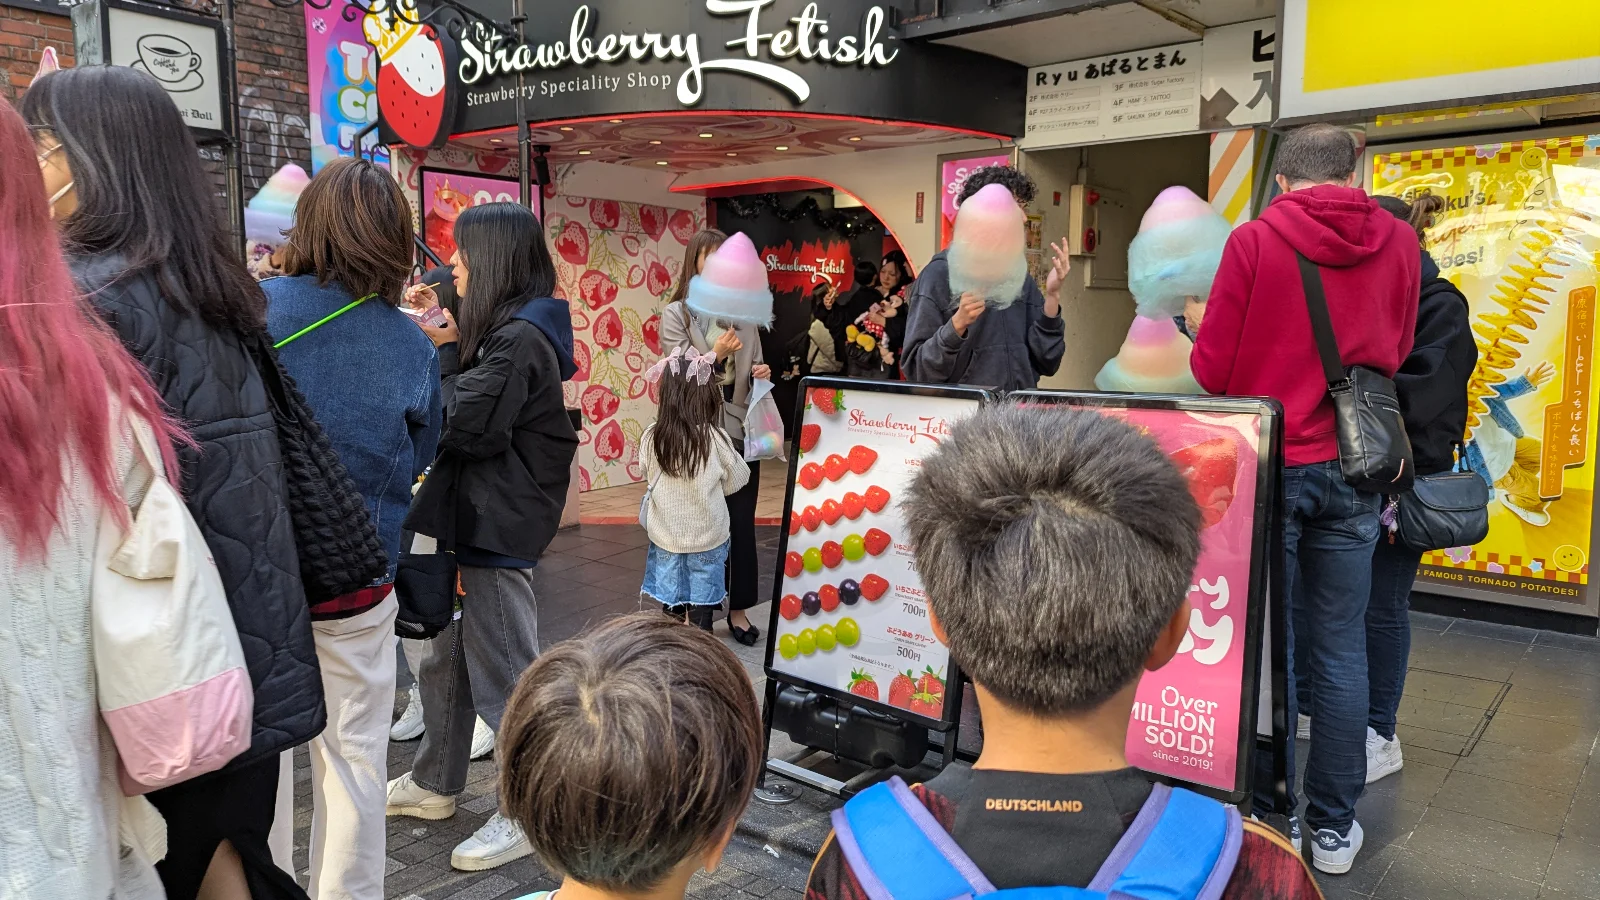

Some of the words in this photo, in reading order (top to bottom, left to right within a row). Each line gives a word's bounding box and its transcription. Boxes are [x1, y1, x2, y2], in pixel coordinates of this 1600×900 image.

[459, 4, 703, 105] Strawberry
[706, 0, 899, 65] Fetish
[1036, 70, 1078, 86] Ryu
[1085, 49, 1187, 79] あぱるとまん
[467, 85, 536, 107] Strawberry
[540, 74, 621, 97] Speciality
[627, 72, 672, 91] Shop
[1115, 84, 1124, 92] 3F
[1029, 95, 1038, 103] 2F
[1113, 99, 1124, 107] 4F
[191, 109, 213, 121] Doll
[1028, 109, 1037, 117] 4F
[1113, 115, 1123, 123] 5F
[766, 254, 816, 284] Strawberry
[816, 257, 845, 275] Fetish
[847, 427, 873, 435] Strawberry
[848, 408, 917, 444] Strawberry
[1423, 569, 1463, 581] FAMOUS
[1467, 575, 1517, 588] TORNADO
[1520, 582, 1579, 597] POTATOES!
[886, 626, 913, 639] ぶどうあめ
[915, 633, 936, 645] グリーン
[896, 645, 921, 662] 500円
[1162, 685, 1218, 715] Over
[1145, 726, 1214, 758] SOLD!
[1153, 750, 1180, 764] since
[1182, 756, 1214, 772] 2019!
[985, 798, 1083, 812] DEUTSCHLAND
